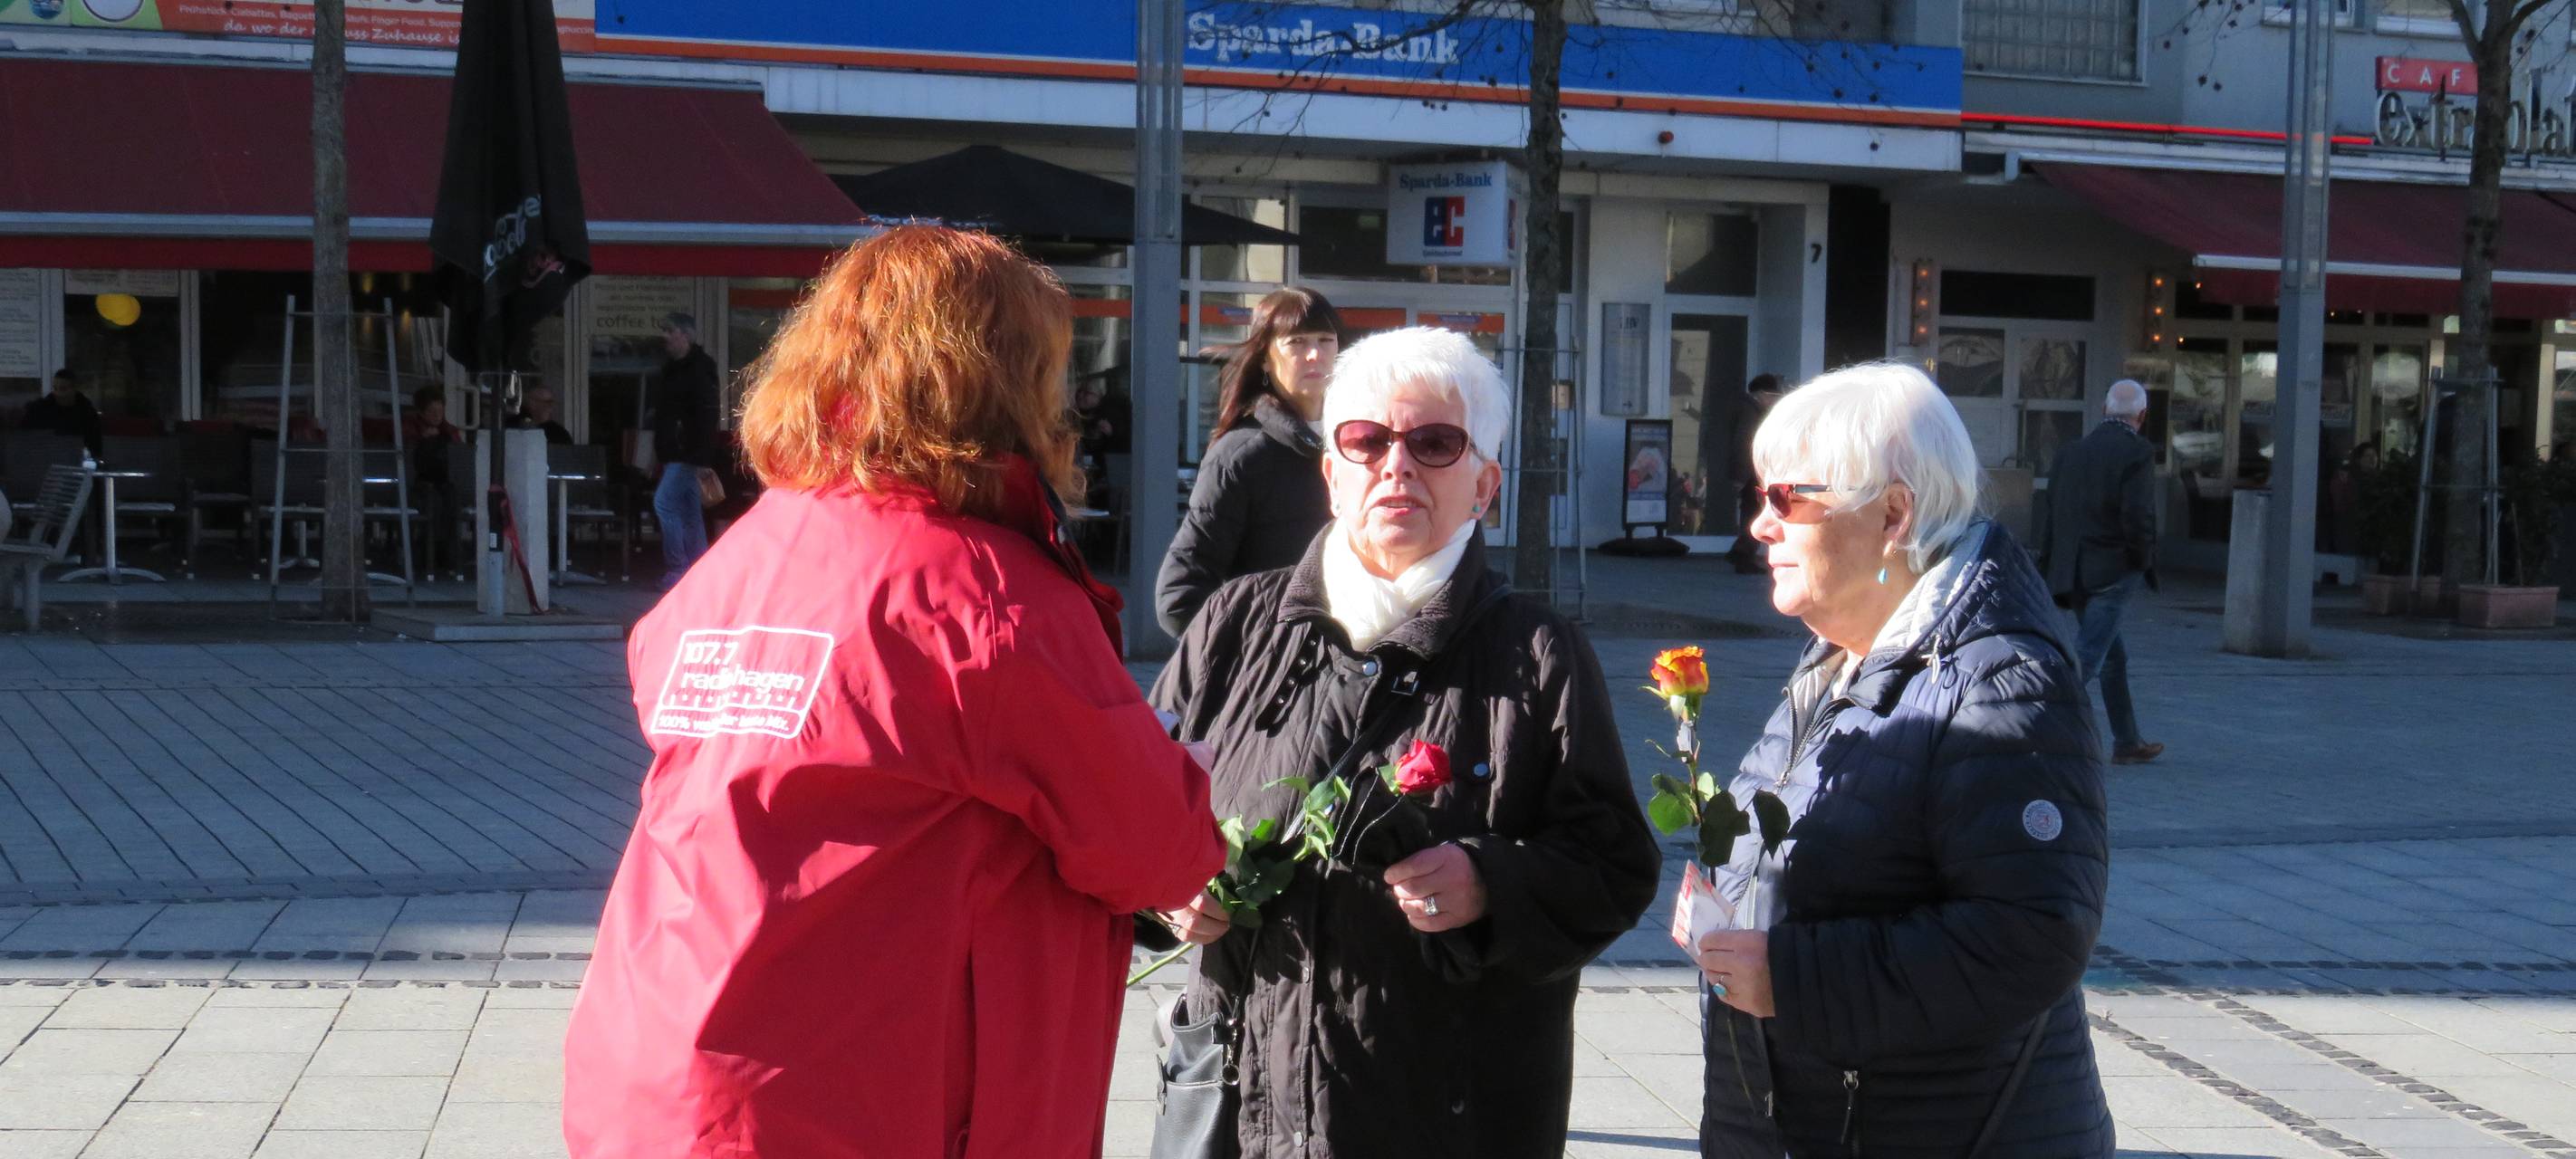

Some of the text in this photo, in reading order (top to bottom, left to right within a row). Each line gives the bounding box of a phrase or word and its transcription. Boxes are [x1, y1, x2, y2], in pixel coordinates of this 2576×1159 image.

[371, 28, 442, 43] Zuhause
[1187, 12, 1459, 64] Sparda-Bank
[2387, 63, 2462, 87] CAF
[1399, 171, 1493, 192] Sparda-Bank
[1810, 243, 1822, 263] 7
[596, 313, 646, 329] coffee
[683, 641, 739, 666] 107.7
